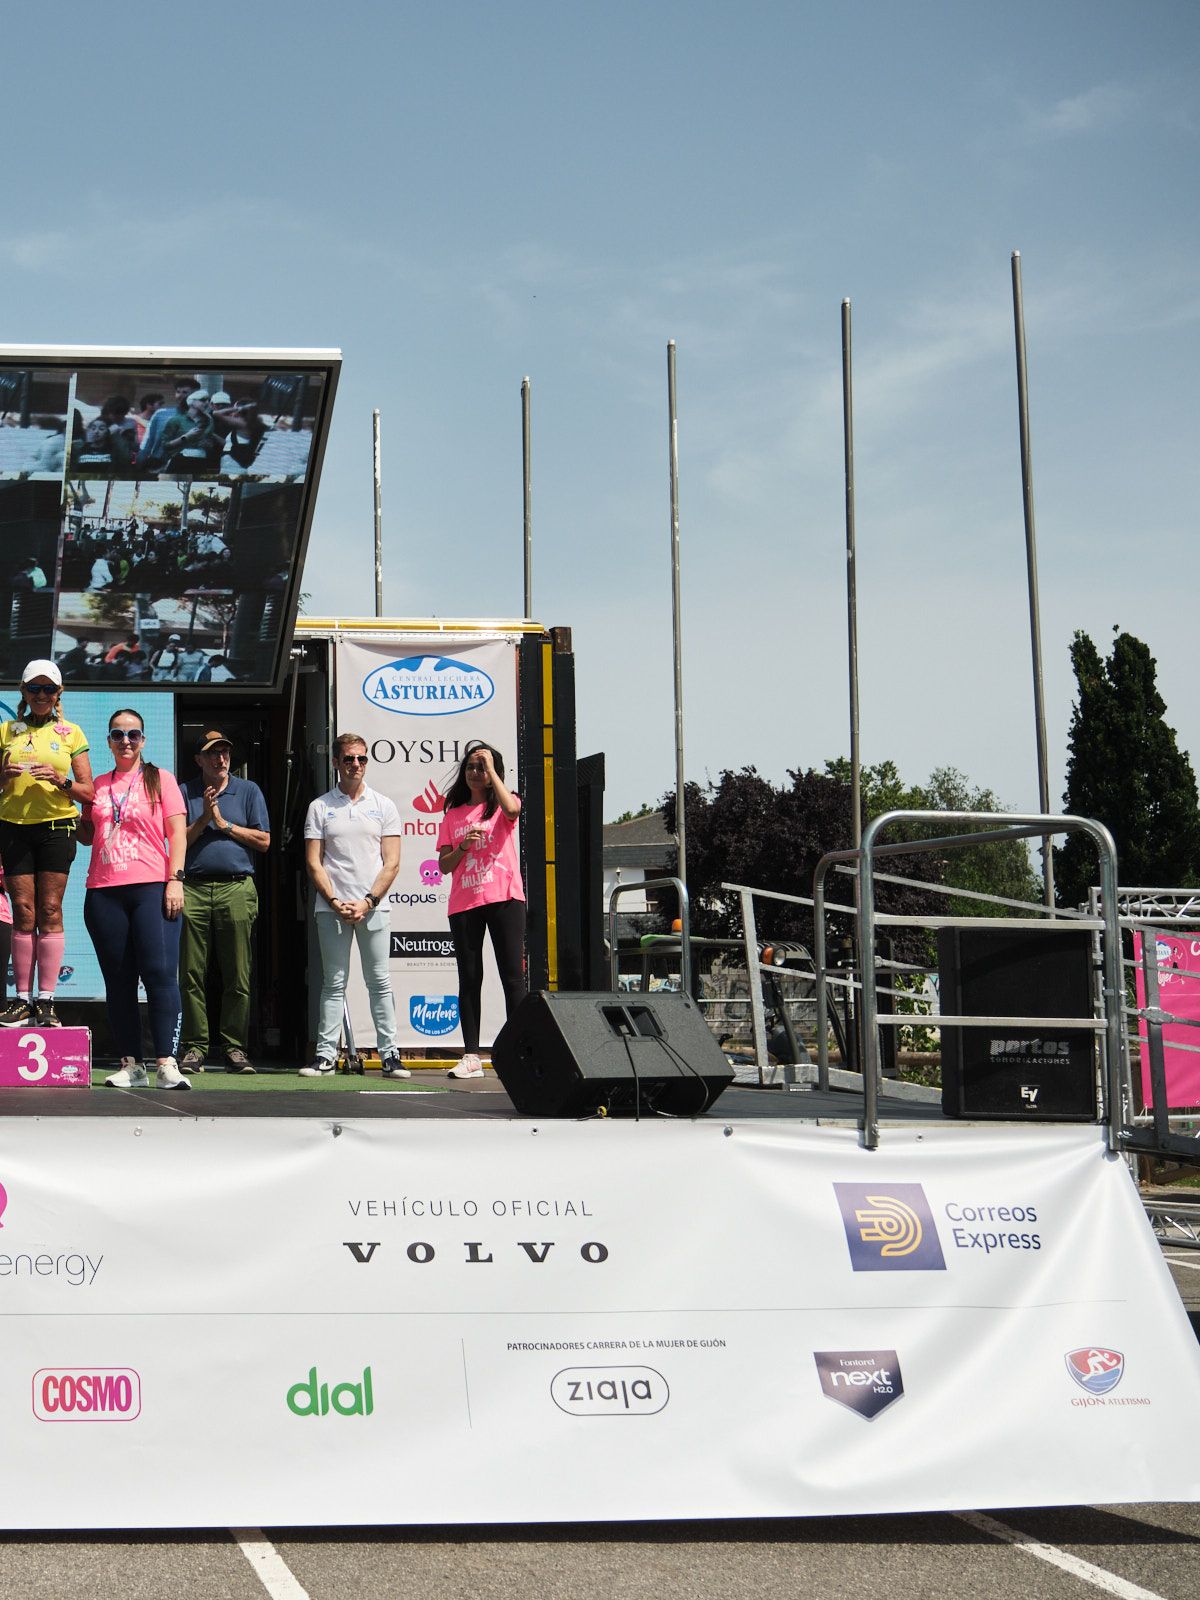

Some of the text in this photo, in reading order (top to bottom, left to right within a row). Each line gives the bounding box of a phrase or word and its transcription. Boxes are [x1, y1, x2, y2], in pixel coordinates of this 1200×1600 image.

[373, 677, 485, 700] ASTURIANA
[392, 674, 434, 682] CENTRAL
[388, 892, 437, 906] ctopus
[412, 1003, 457, 1026] Marlene
[172, 1012, 183, 1056] adidas
[18, 1033, 49, 1082] 3
[990, 1038, 1069, 1055] portos
[348, 1196, 593, 1216] VEHÍCULO OFICIAL
[944, 1202, 1038, 1222] Correos
[342, 1241, 609, 1264] VOLVO
[952, 1228, 1041, 1254] Express
[507, 1338, 726, 1351] PATROCINADORES CARRERA DE LA MUJER DE GIJÓN
[830, 1368, 892, 1386] next
[42, 1375, 132, 1413] COSMO
[286, 1365, 374, 1416] dial
[567, 1379, 652, 1409] ziaja
